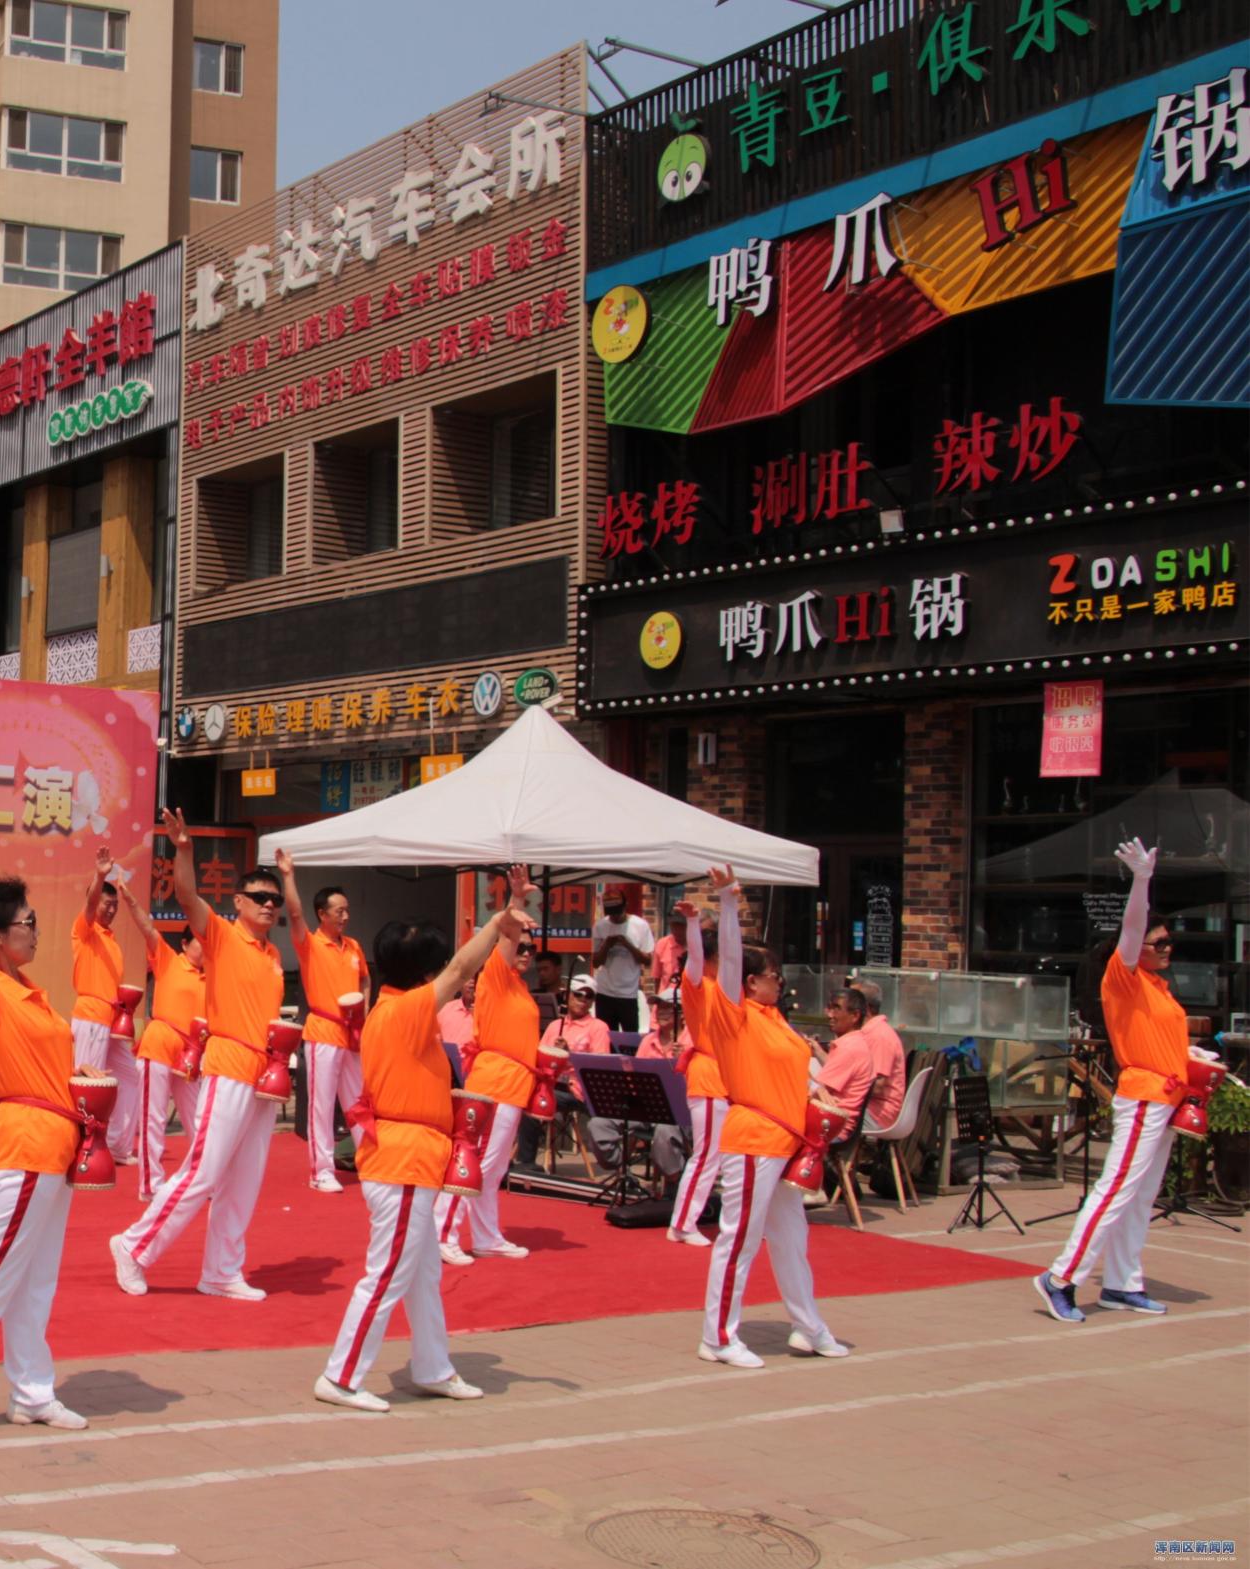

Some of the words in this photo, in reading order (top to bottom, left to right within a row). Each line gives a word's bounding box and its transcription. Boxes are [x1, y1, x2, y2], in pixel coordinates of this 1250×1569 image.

[730, 0, 1184, 174] 青豆·俱乐
[188, 111, 567, 331] 北奇达汽车会所
[381, 243, 496, 321] 全车贴膜
[505, 217, 569, 274] 钣金
[598, 479, 700, 560] 烧烤
[751, 442, 870, 534] 涮肚
[934, 396, 1081, 496] 辣炒
[1047, 581, 1237, 625] 不只是一家鸭店
[234, 704, 275, 739] 保险
[286, 695, 332, 734] 理赔
[341, 688, 392, 729] 保养
[404, 678, 463, 718] 车衣
[523, 676, 544, 688] LAND
[525, 687, 551, 700] ROVER
